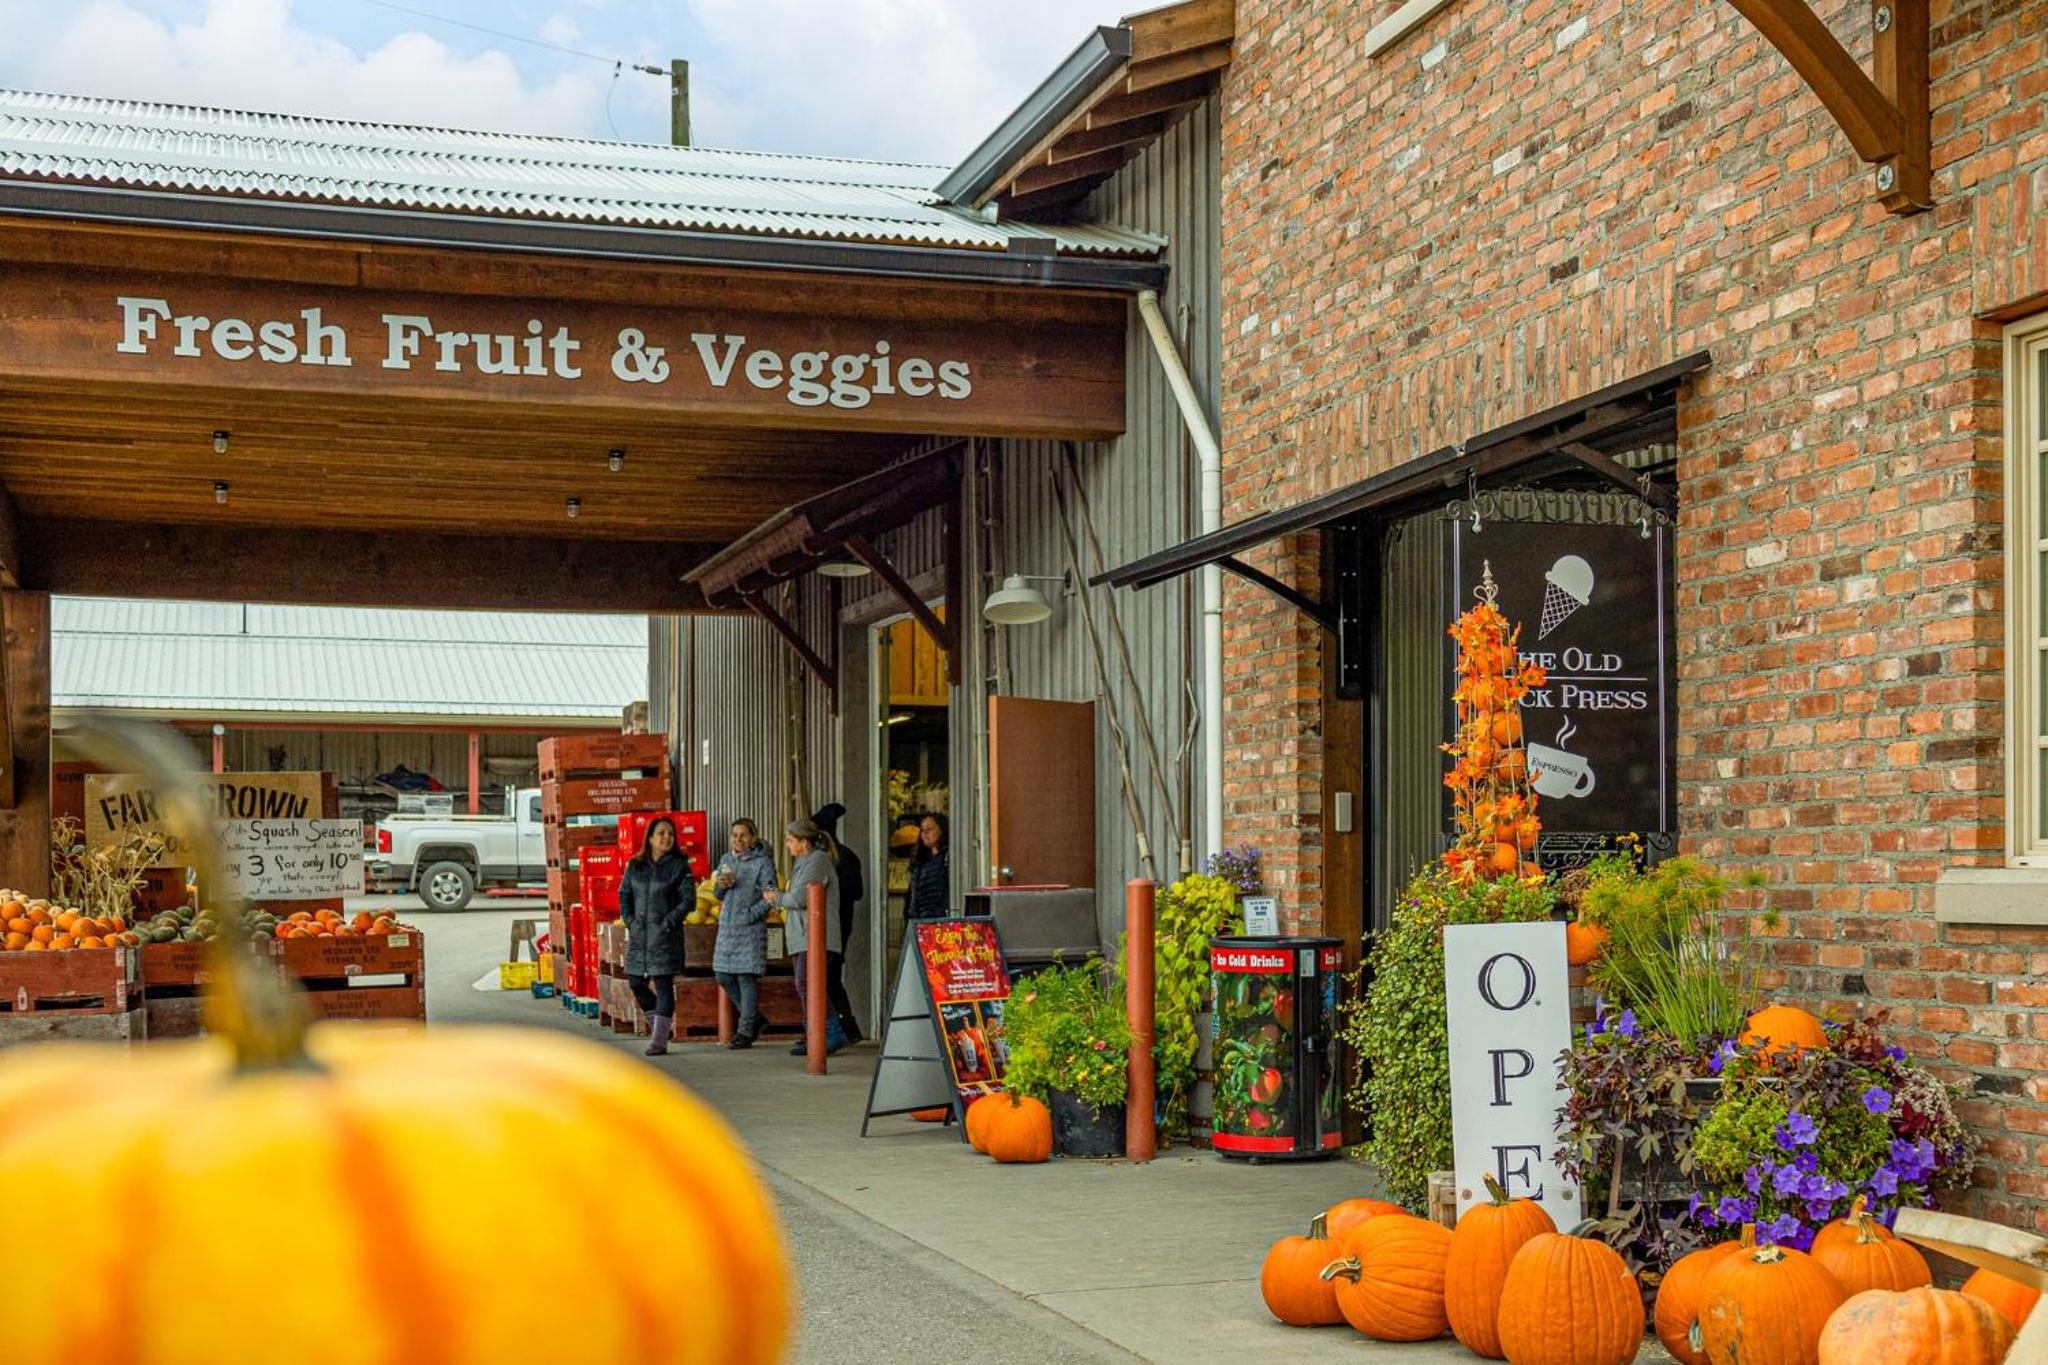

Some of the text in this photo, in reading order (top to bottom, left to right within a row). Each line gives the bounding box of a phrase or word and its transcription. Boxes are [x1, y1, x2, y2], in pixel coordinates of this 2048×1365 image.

[116, 296, 973, 409] Fresh Fruit & Veggies
[1513, 646, 1623, 672] HE OLD
[1560, 684, 1649, 711] PRESS
[1531, 757, 1578, 778] ESPRESSO
[248, 820, 299, 846] Squash
[304, 819, 362, 842] Season!
[246, 854, 265, 877] 3
[274, 854, 296, 872] for
[302, 854, 325, 873] only
[1228, 954, 1246, 967] Cold
[1249, 954, 1285, 968] Drinks
[1477, 952, 1544, 1201] OPE
